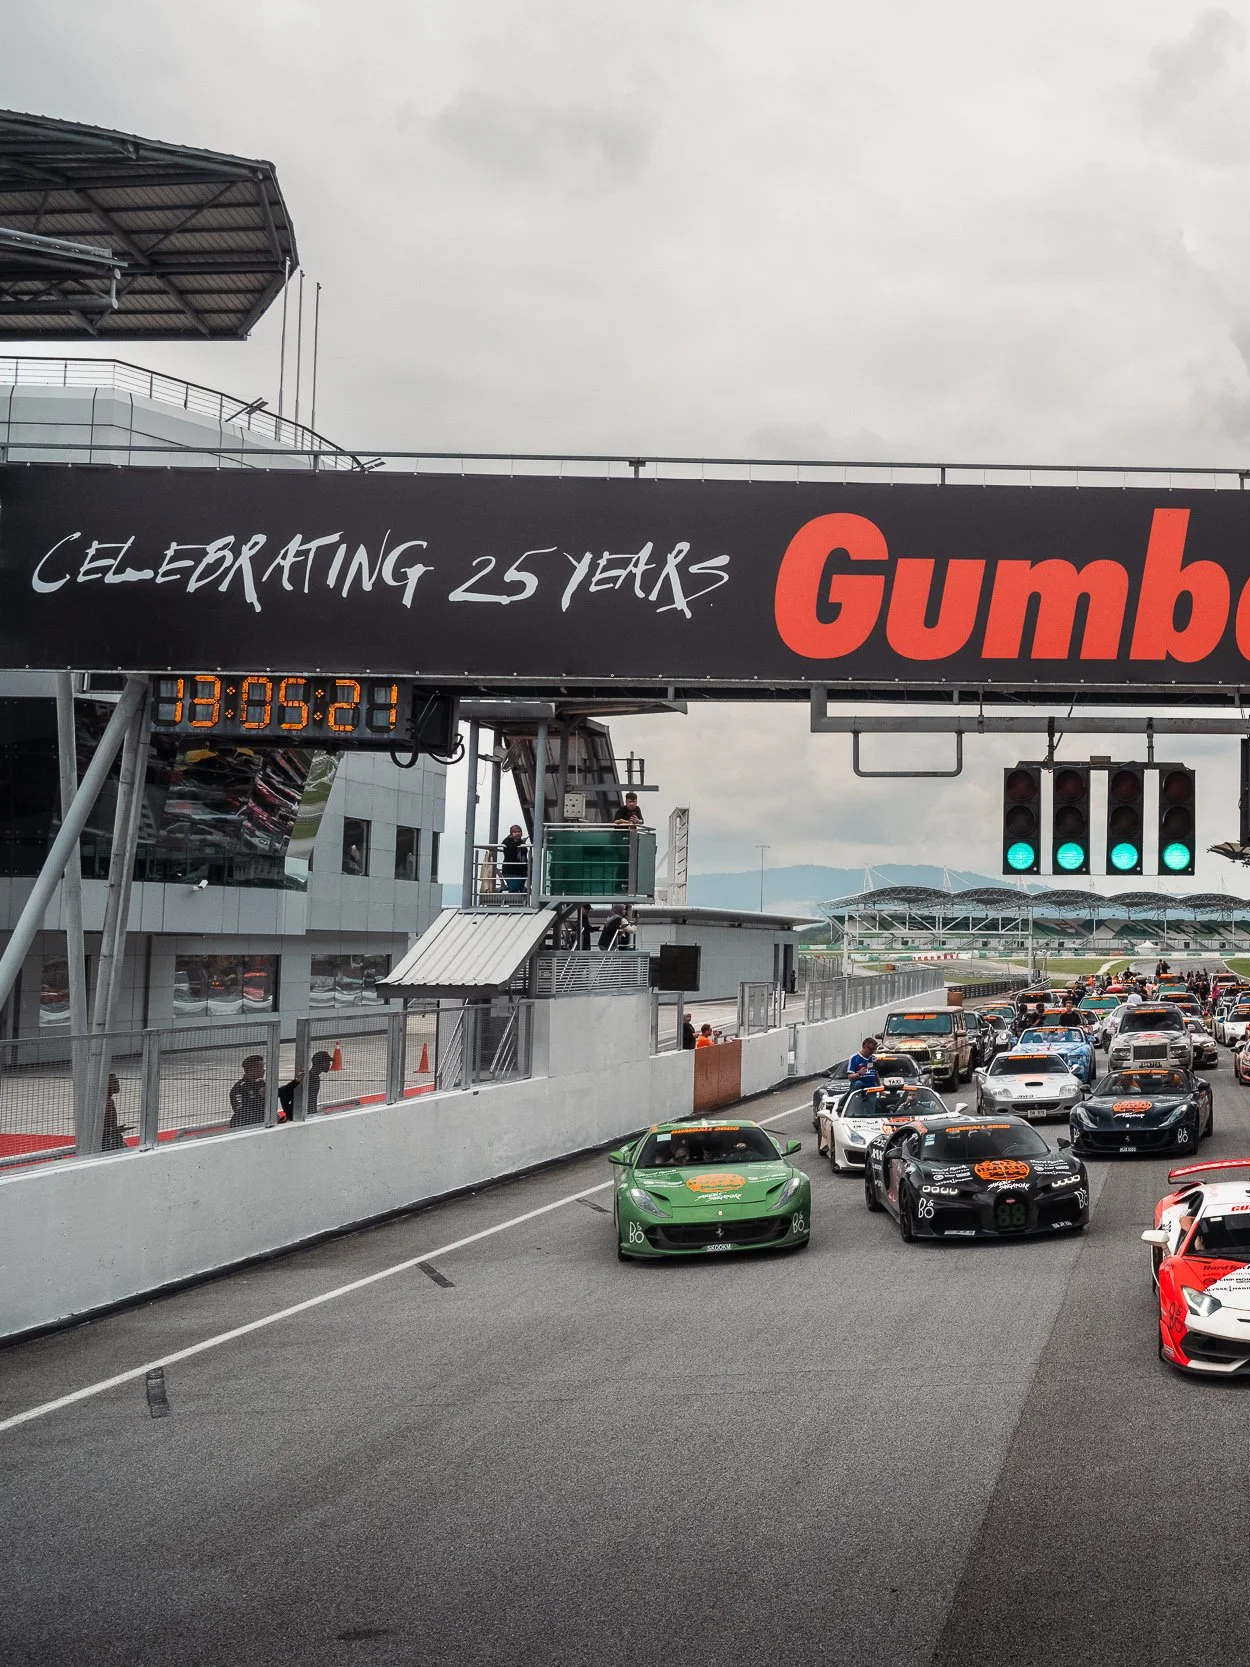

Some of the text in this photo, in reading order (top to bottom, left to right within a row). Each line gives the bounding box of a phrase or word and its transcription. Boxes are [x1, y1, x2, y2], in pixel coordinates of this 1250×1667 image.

[32, 529, 730, 618] CELEBRATING 25 YEARS
[176, 675, 398, 732] 13:05:21
